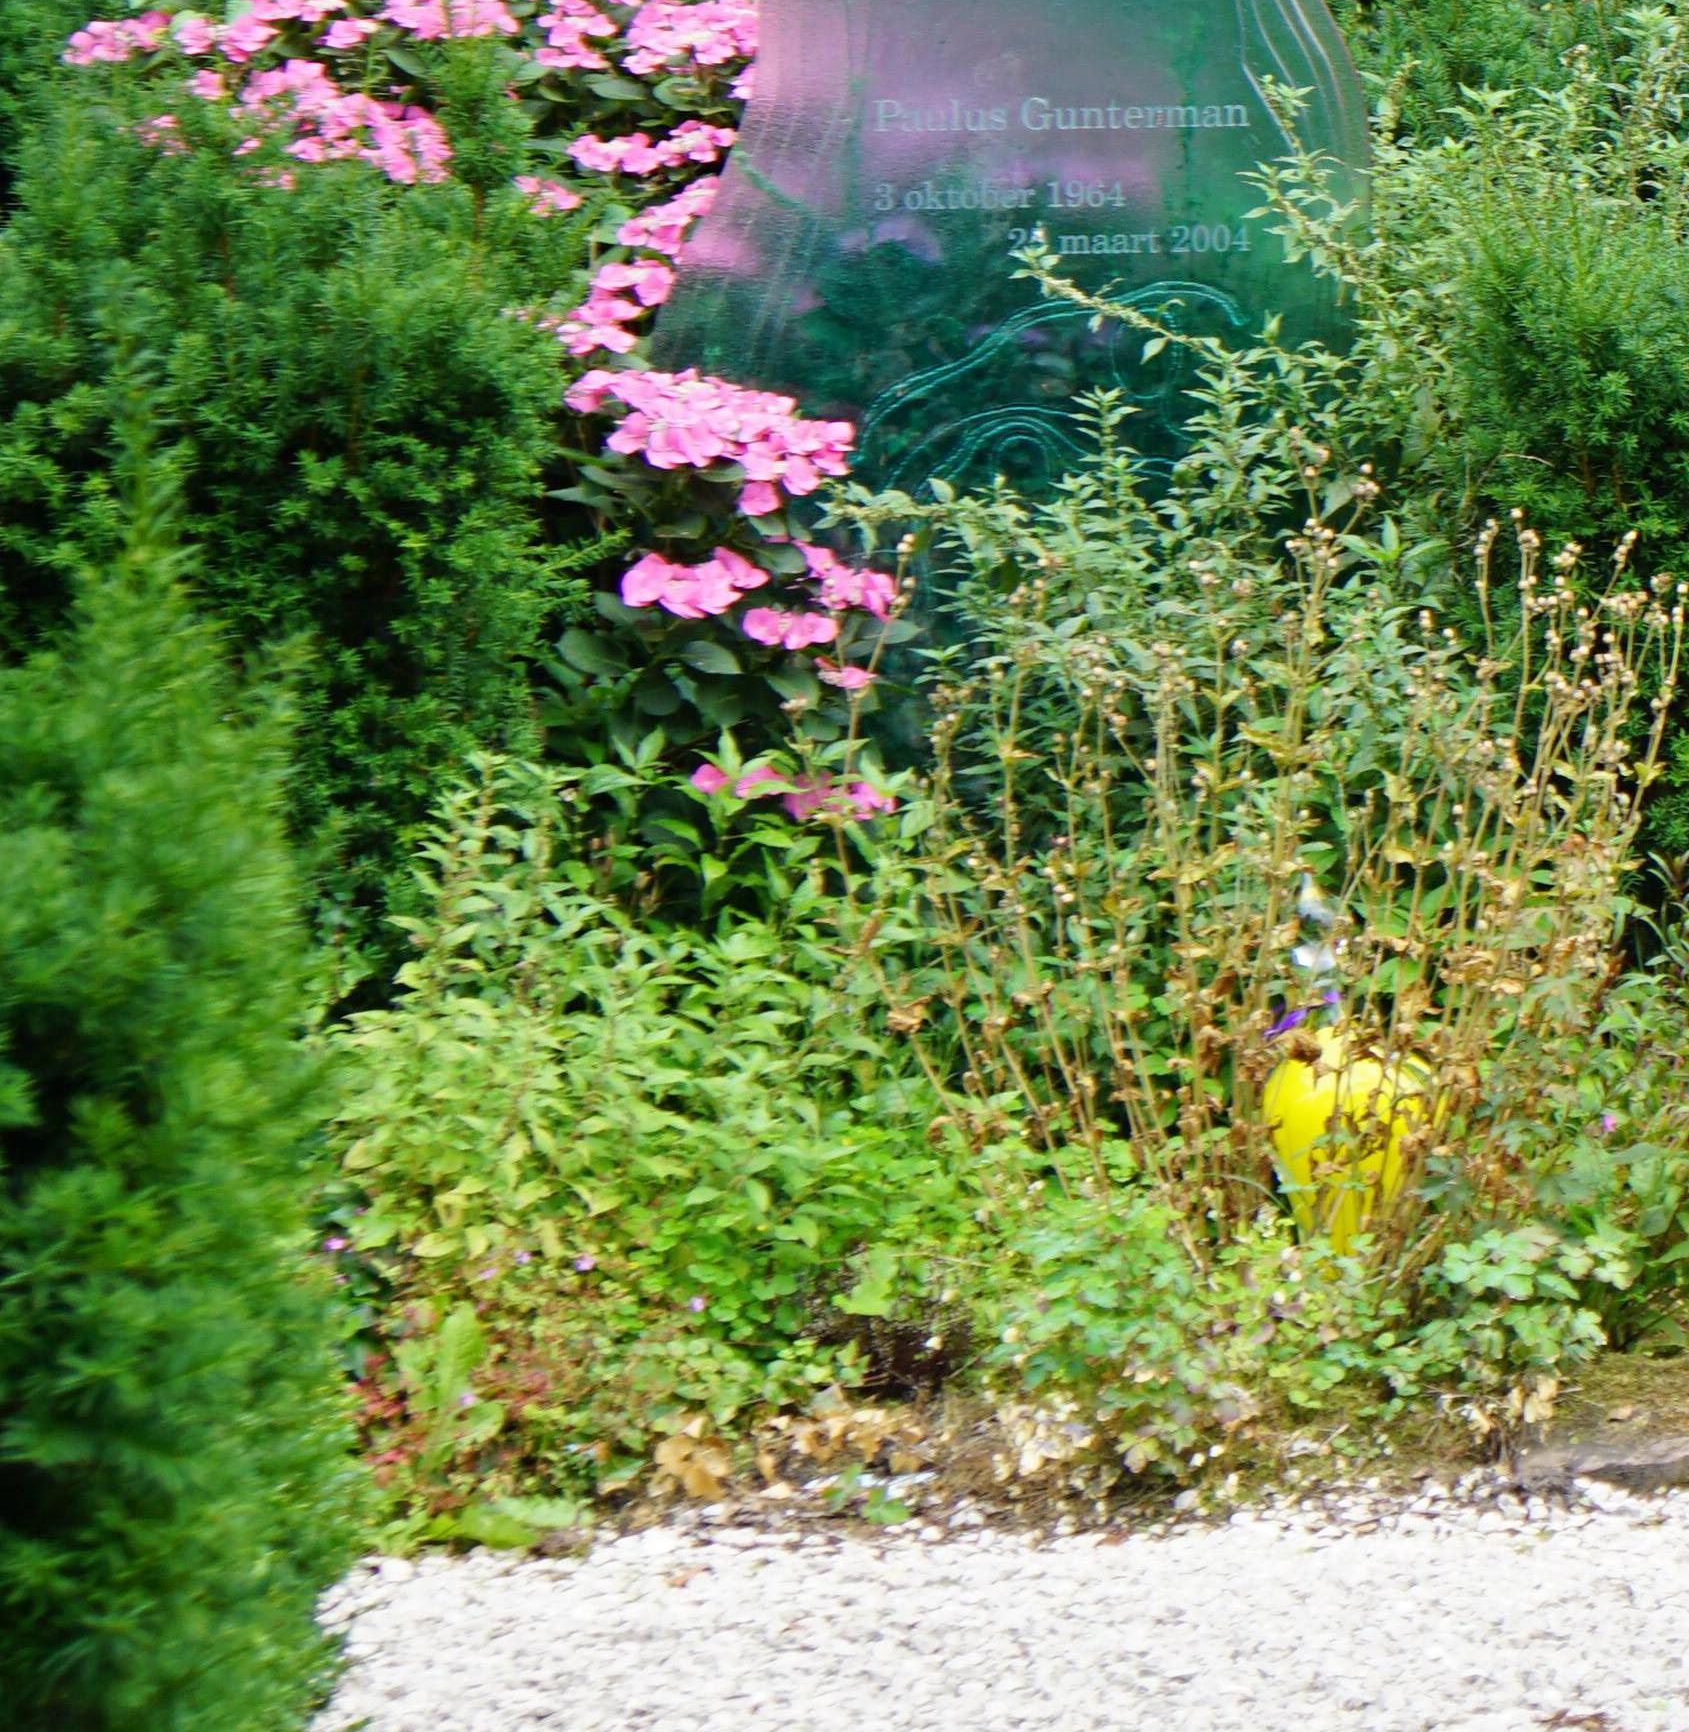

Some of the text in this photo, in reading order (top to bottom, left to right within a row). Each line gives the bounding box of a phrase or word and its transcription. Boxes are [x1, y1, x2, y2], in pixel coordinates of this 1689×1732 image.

[872, 97, 1251, 133] Paulus Gunterman
[874, 181, 1126, 211] 3 oktober 1964
[1058, 230, 1161, 256] maart
[1170, 225, 1251, 253] 2004
